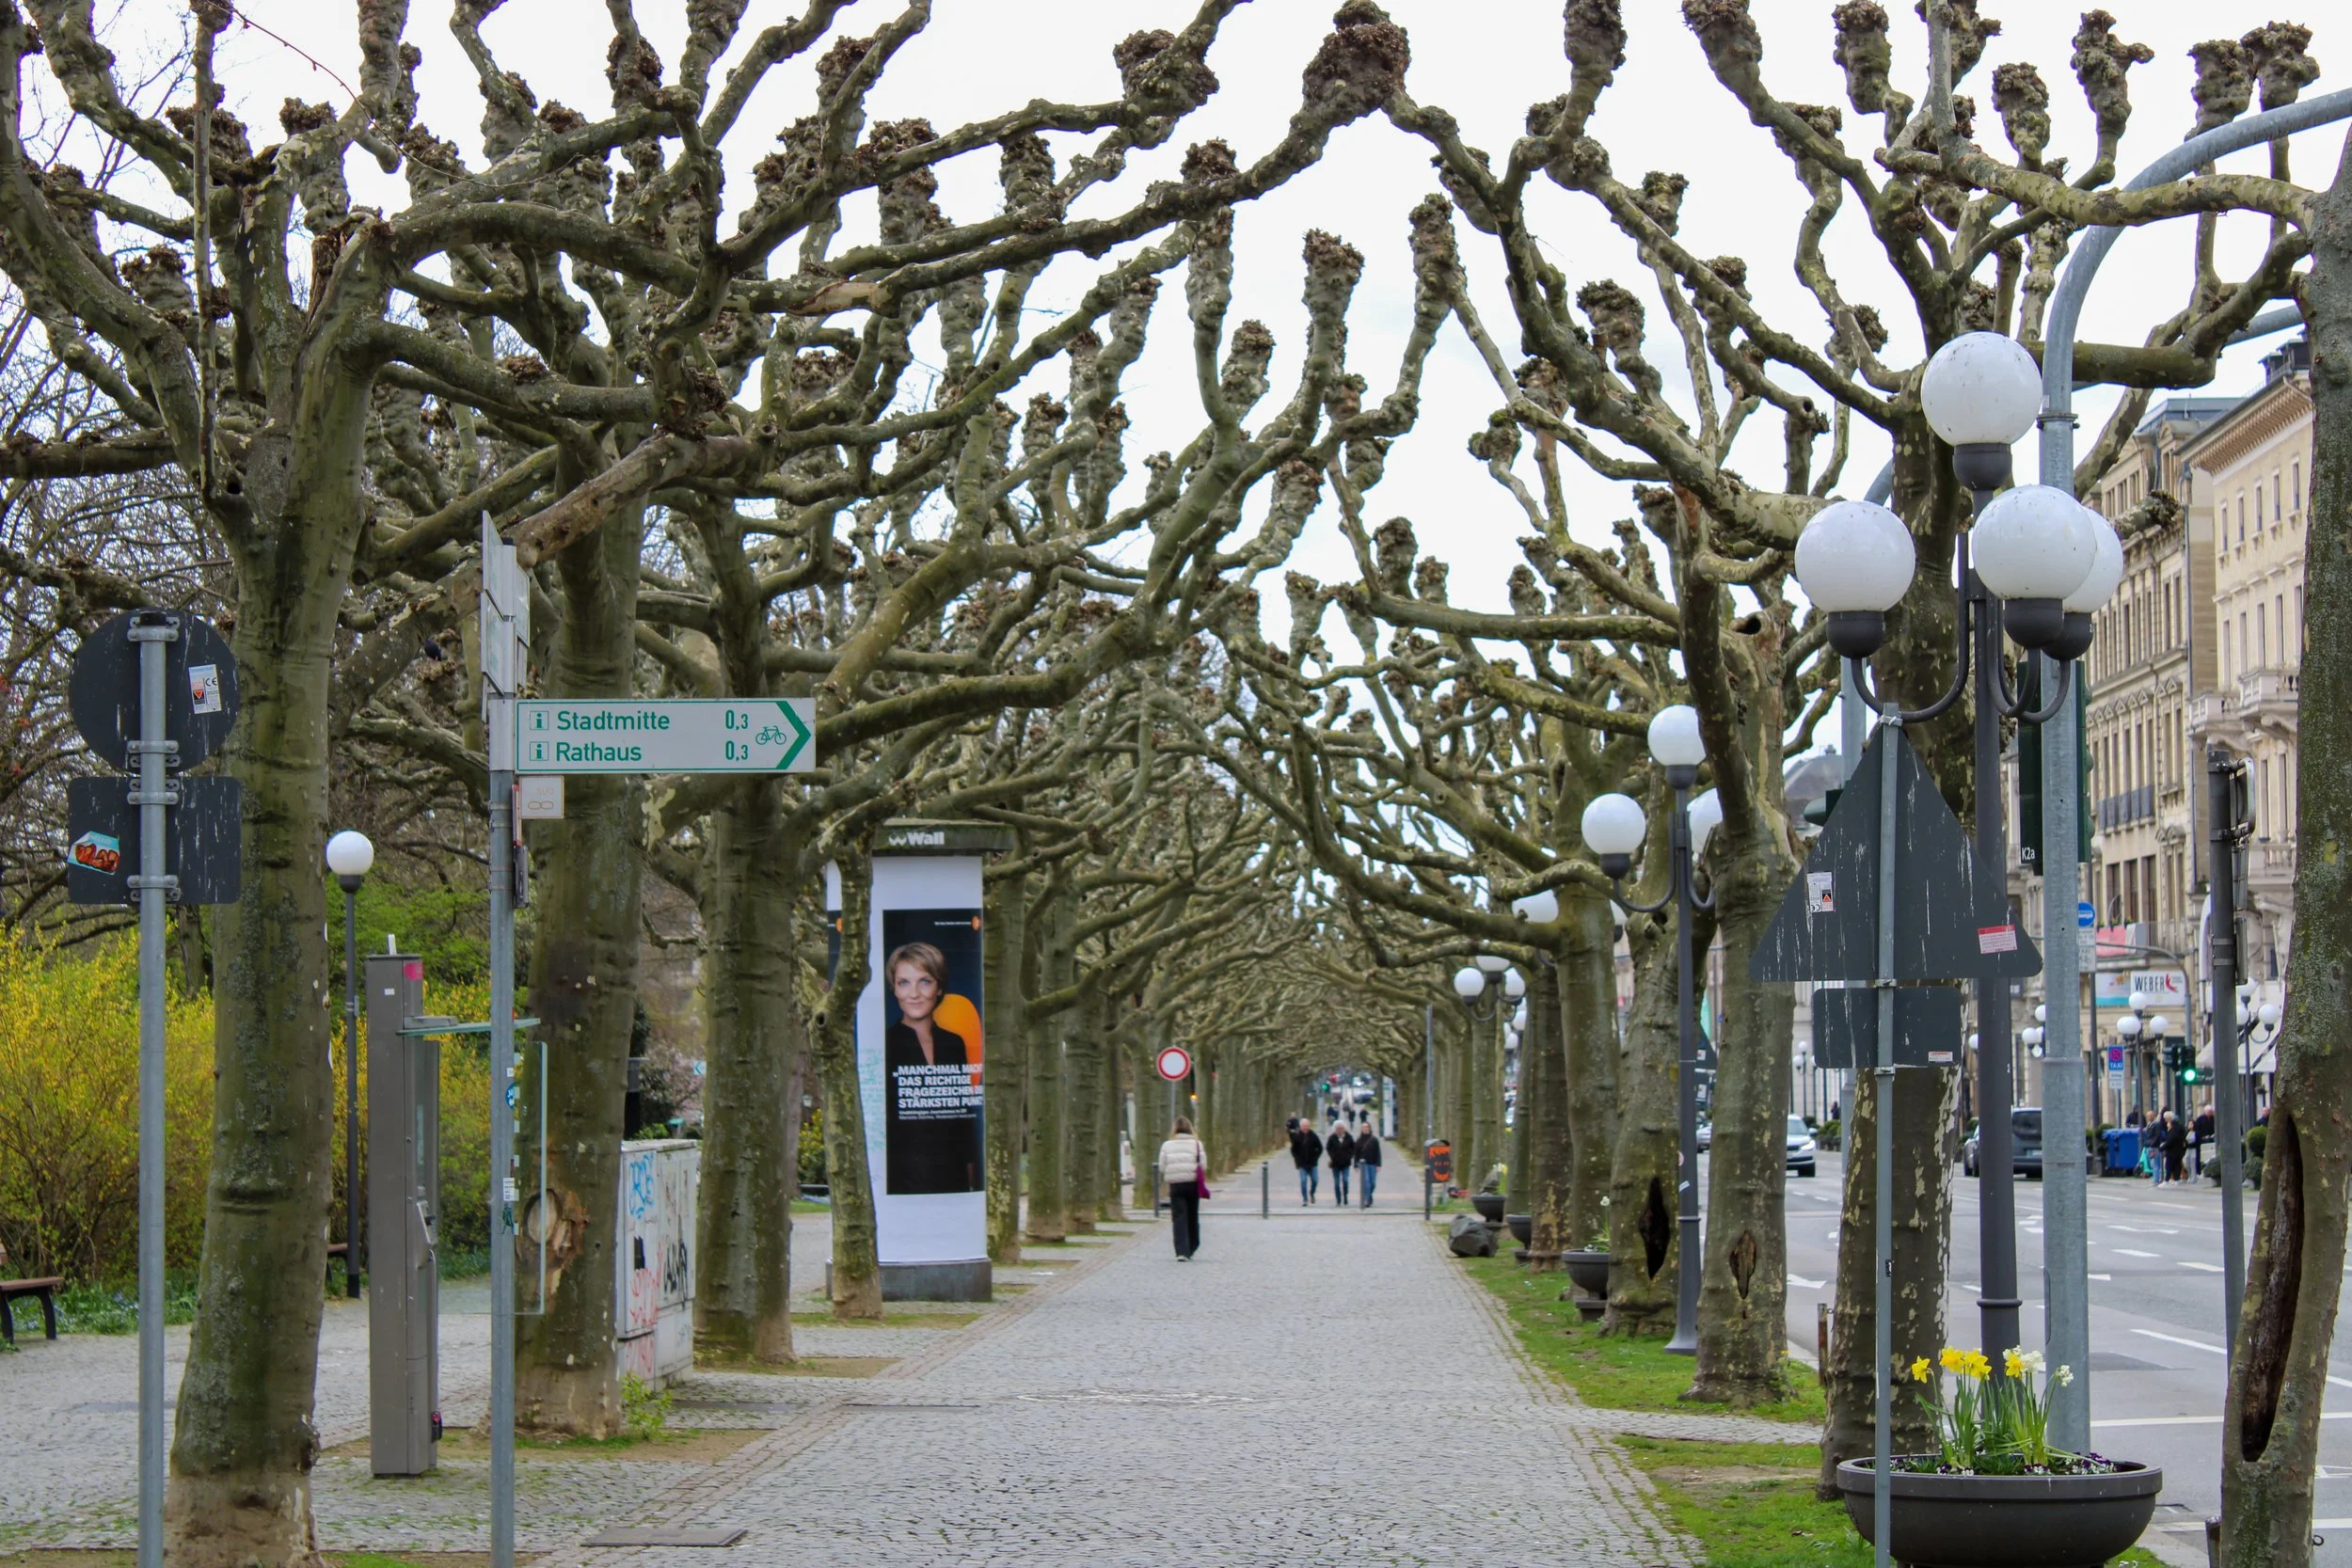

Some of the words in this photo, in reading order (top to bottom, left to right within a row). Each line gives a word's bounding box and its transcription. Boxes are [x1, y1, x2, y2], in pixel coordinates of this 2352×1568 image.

[557, 710, 670, 730] Stadtmitte
[725, 709, 748, 730] 0,3
[556, 742, 642, 761] Rathaus
[725, 740, 748, 761] 0,3
[907, 832, 945, 845] Wall
[2022, 847, 2035, 860] K2a
[2135, 976, 2164, 991] WEBER
[898, 1076, 922, 1086] DAS
[924, 1075, 971, 1085] RICHTIGE
[898, 1085, 974, 1097] FRAGEZEICHEN
[898, 1097, 960, 1108] STÄRKSTEN
